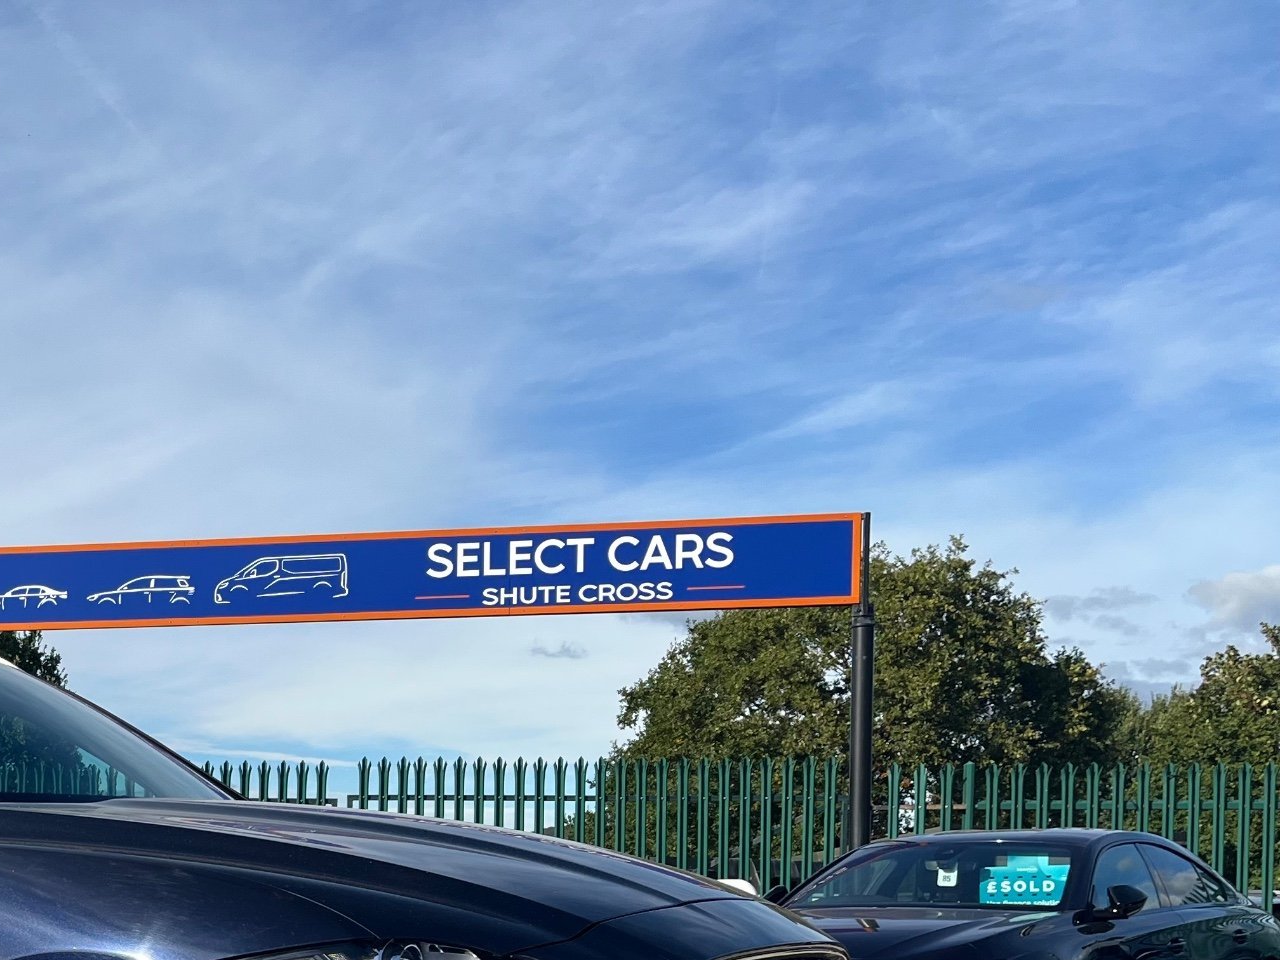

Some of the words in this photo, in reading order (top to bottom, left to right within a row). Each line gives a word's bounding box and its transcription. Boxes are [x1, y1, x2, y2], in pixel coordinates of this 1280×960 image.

[426, 538, 595, 578] SELECT
[607, 532, 735, 572] CARS
[481, 584, 571, 606] SHUTE
[578, 581, 674, 604] CROSS
